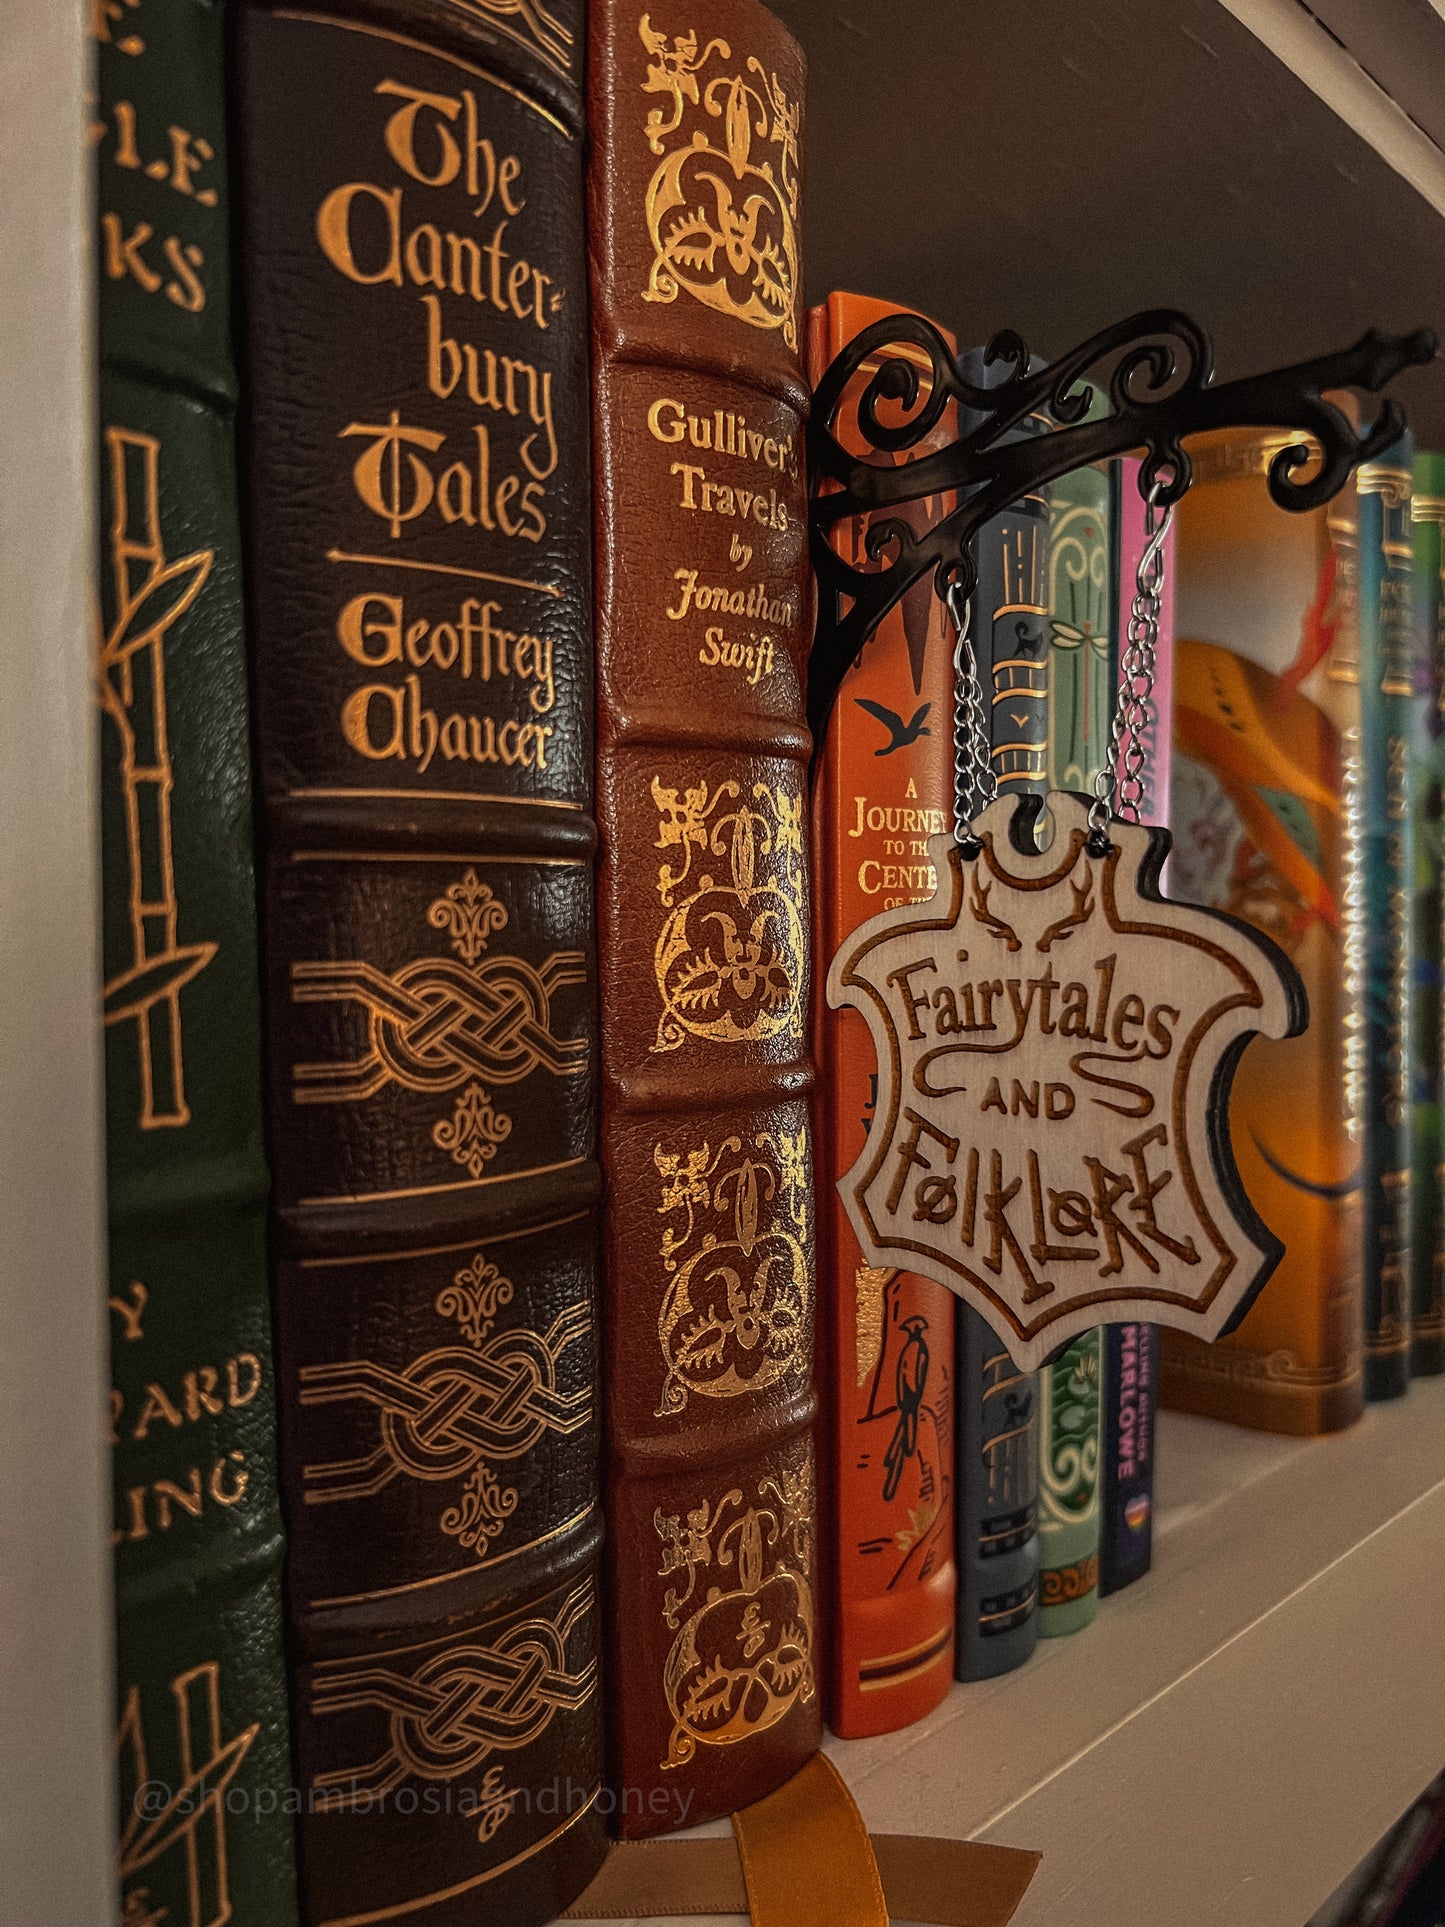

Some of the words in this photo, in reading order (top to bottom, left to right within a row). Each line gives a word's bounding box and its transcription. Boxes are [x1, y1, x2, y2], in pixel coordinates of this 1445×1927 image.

[375, 79, 524, 217] The
[316, 181, 566, 330] Canter-
[420, 294, 558, 481] bury
[647, 398, 799, 482] Gulliver's
[338, 411, 547, 544] Tales
[670, 461, 790, 532] Travels
[729, 533, 753, 573] by
[666, 567, 794, 628] Jonathan
[336, 592, 556, 713] Geoffrey
[699, 626, 774, 685] Swift
[340, 673, 554, 774] Chaucer
[847, 796, 948, 837] JOURNEY
[904, 777, 918, 799] A
[857, 860, 938, 894] CENTE
[882, 839, 905, 855] TO
[909, 840, 930, 857] TH
[886, 951, 1180, 1062] Fairytales
[980, 1076, 1076, 1120] AND
[1138, 1323, 1150, 1387] ELLING
[1117, 1324, 1138, 1481] MARLOWE
